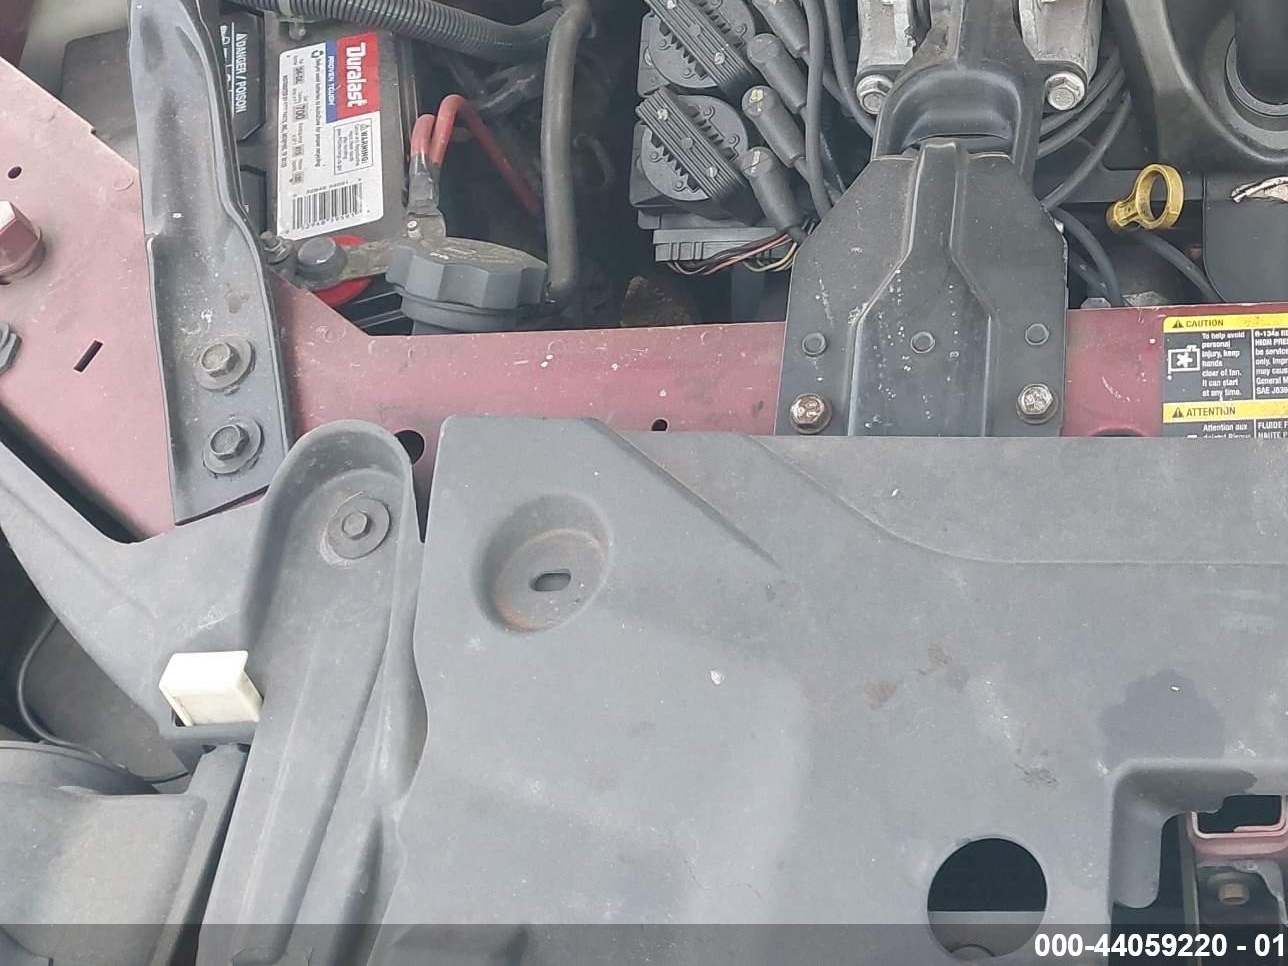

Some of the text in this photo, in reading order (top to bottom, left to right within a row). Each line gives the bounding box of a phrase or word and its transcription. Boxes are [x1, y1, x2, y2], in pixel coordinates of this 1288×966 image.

[236, 41, 247, 75] DANGER
[346, 42, 368, 108] Duralast
[235, 80, 248, 114] POISON
[295, 105, 306, 120] 700
[1186, 319, 1224, 328] CAUTION
[1202, 331, 1246, 341] To help avoid
[1254, 329, 1280, 337] R-134a
[1201, 341, 1231, 349] personal
[1255, 338, 1273, 346] HIGH
[1223, 350, 1241, 358] keep
[1255, 347, 1264, 356] be
[1256, 368, 1271, 376] may
[1222, 378, 1239, 386] start
[1256, 377, 1281, 385] General
[1202, 388, 1242, 398] at any time.
[1256, 387, 1271, 395] SAE
[1186, 406, 1236, 417] ATTENTION
[1202, 423, 1248, 432] Attention aux
[1257, 421, 1283, 429] FLUIDE
